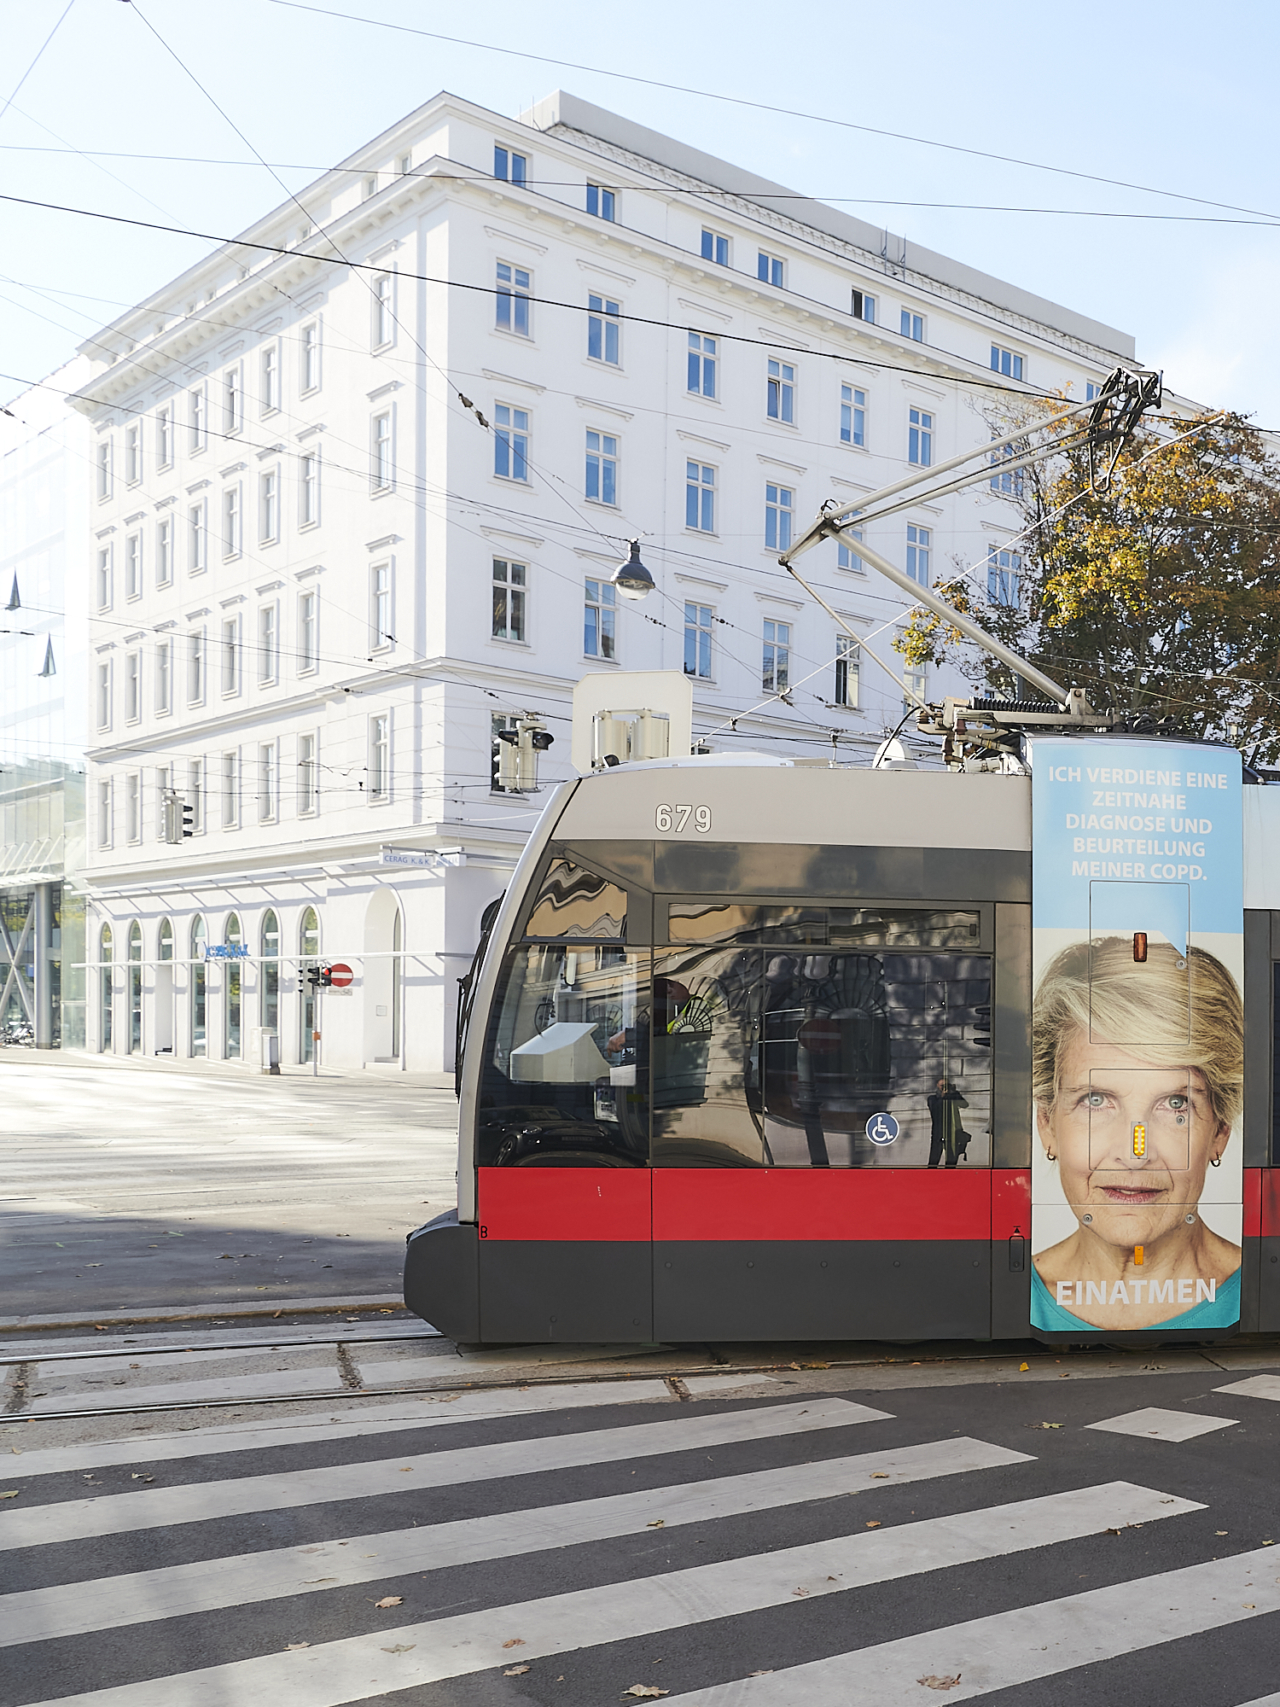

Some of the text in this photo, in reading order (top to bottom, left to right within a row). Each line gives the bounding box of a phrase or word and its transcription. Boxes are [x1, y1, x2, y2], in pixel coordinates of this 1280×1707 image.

[1049, 766, 1228, 790] ICH VERDIENE EINE
[1092, 791, 1187, 810] ZEITNAHE
[655, 803, 712, 834] 679
[1065, 813, 1213, 835] DIAGNOSE UND
[1072, 837, 1206, 858] BEURTEILUNG
[1071, 861, 1208, 882] MEINER COPD.
[1056, 1278, 1217, 1306] EINATMEN
